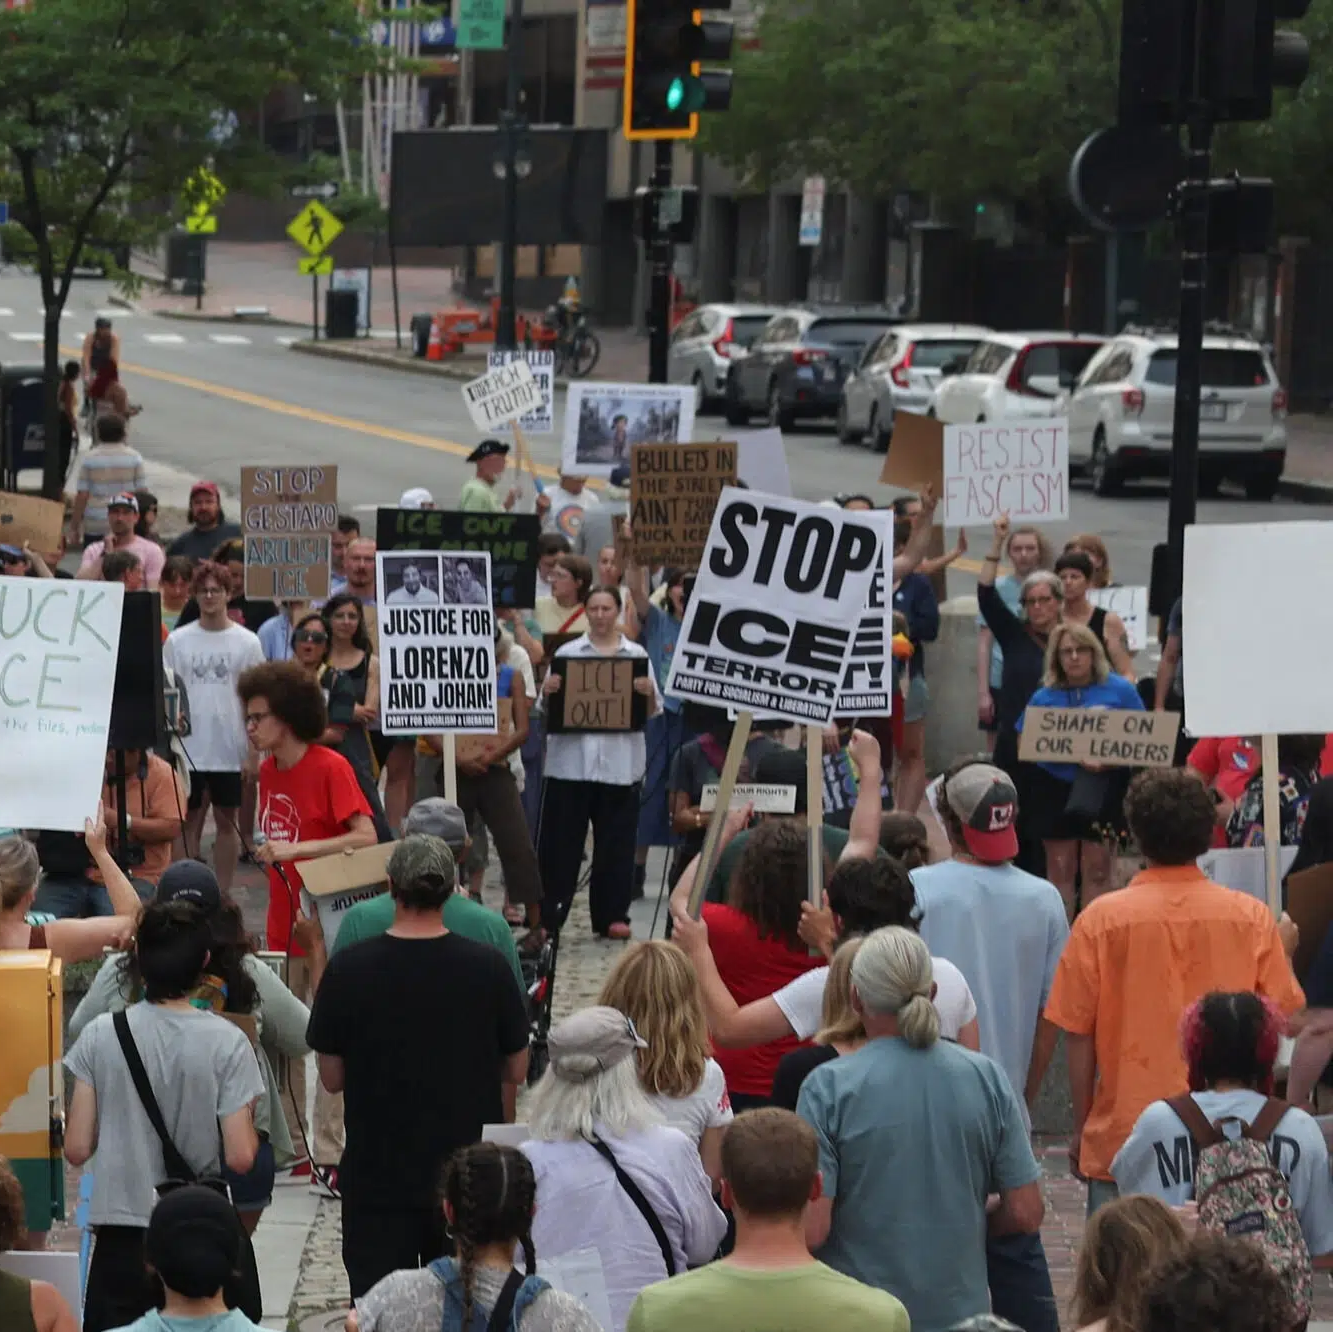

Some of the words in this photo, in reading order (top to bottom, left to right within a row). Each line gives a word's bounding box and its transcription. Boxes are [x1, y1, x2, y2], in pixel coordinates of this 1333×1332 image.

[716, 448, 733, 471] IN
[958, 427, 1064, 472] RESIST
[252, 467, 324, 496] STOP
[639, 479, 667, 494] THE
[945, 473, 1065, 517] FASCISM
[245, 504, 337, 531] GESTAPO
[396, 512, 442, 535] ICE
[463, 516, 517, 536] OUT
[247, 536, 329, 566] ABOLISH
[709, 502, 877, 601] STOP
[271, 567, 309, 597] ICE
[384, 609, 457, 635] JUSTICE
[462, 609, 491, 636] FOR
[687, 600, 851, 675] ICE
[389, 646, 489, 680] LORENZO
[682, 650, 838, 697] TERROR
[574, 661, 623, 693] ICE
[388, 682, 426, 710] AND
[432, 682, 493, 709] JOHAN!
[675, 675, 702, 692] PARTY
[704, 681, 721, 695] FOR
[722, 684, 770, 706] SOCIALISM
[778, 696, 828, 719] LIBERATION
[838, 695, 886, 708] LIBERATION
[2, 715, 28, 732] the
[387, 715, 408, 727] PARTY
[409, 715, 423, 727] FOR
[423, 715, 457, 727] SOCIALISM
[463, 715, 494, 727] LIBERATION
[571, 700, 625, 727] OUT!
[1040, 712, 1109, 733] SHAME
[1123, 716, 1154, 733] ON
[1036, 738, 1072, 755] OUR
[1089, 740, 1170, 762] LEADERS
[733, 787, 754, 796] YOUR
[756, 787, 788, 797] RIGHTS
